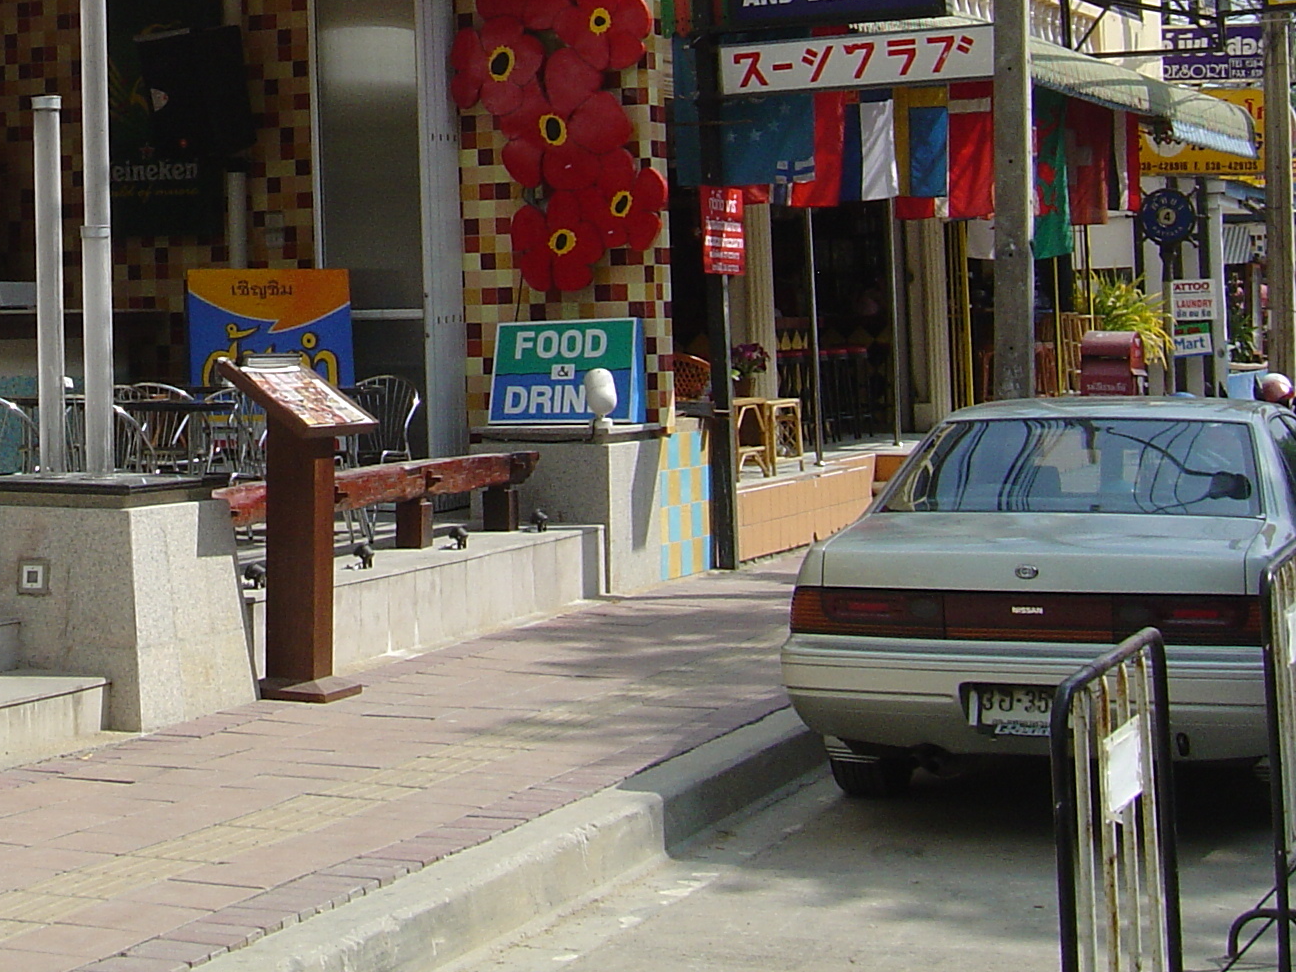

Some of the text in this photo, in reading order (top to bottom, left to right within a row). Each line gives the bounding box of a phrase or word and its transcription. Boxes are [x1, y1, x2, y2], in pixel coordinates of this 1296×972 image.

[1163, 64, 1228, 78] RESORT
[108, 159, 198, 181] eineken
[1164, 212, 1171, 221] 4
[1176, 299, 1213, 308] LAUNDRY
[515, 329, 608, 359] FOOD
[1174, 336, 1205, 349] Mart
[557, 366, 569, 377] &
[504, 385, 595, 414] DRIN
[1011, 606, 1043, 615] NISSAN
